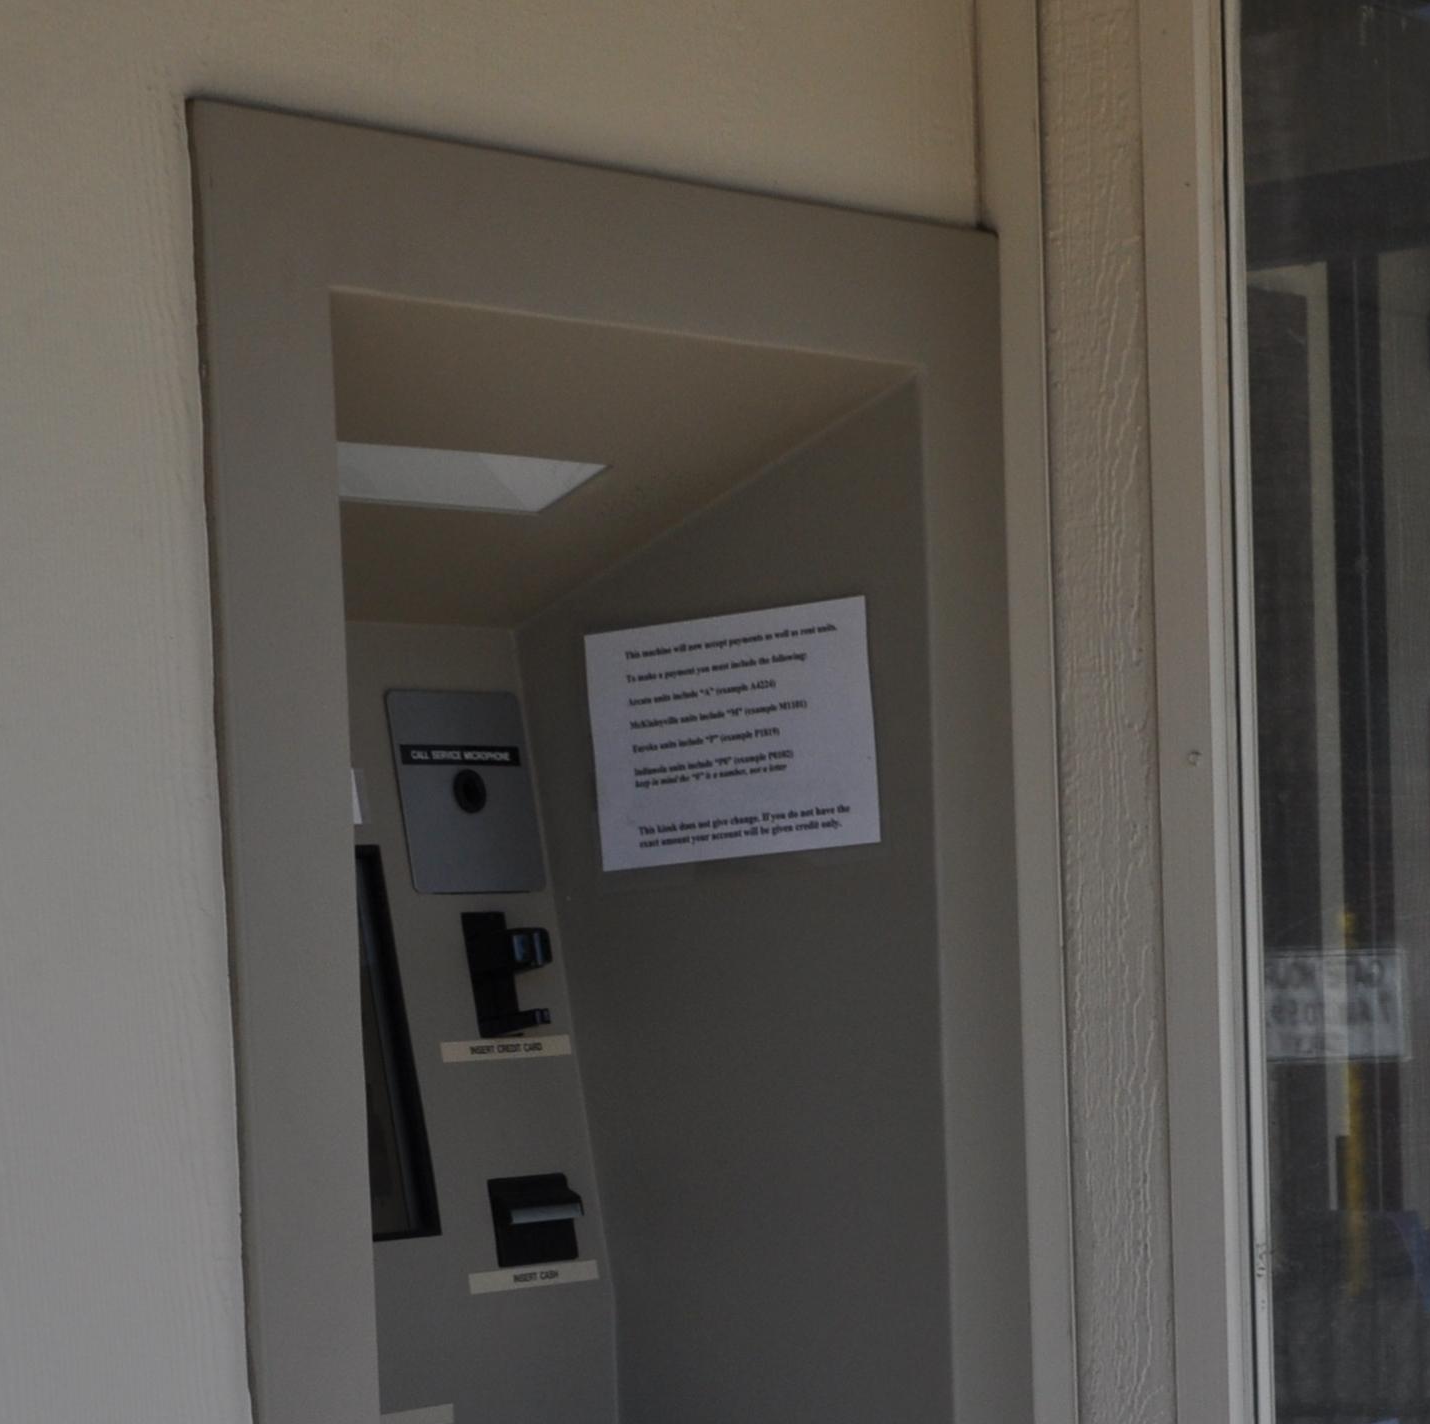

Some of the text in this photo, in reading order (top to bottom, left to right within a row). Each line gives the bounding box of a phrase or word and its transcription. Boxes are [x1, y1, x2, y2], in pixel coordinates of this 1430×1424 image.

[625, 650, 640, 660] This
[642, 646, 671, 658] machine
[674, 644, 687, 654] will
[688, 643, 702, 652] now
[705, 638, 727, 652] accept
[729, 634, 763, 649] payments
[774, 630, 789, 641] well
[801, 627, 815, 638] rent
[638, 671, 657, 682] make
[664, 666, 695, 680] payment
[696, 666, 710, 676] you
[711, 662, 729, 673] must
[730, 658, 757, 670] include
[758, 657, 770, 667] the
[653, 693, 671, 704] units
[672, 690, 698, 701] include
[680, 713, 698, 724] units
[699, 710, 725, 722] include
[659, 740, 677, 750] units
[678, 736, 704, 748] include
[411, 750, 511, 761] CALL SERVICE MICROPHONE
[669, 762, 686, 772] units
[687, 759, 713, 770] include
[639, 825, 656, 835] This
[679, 821, 696, 831] does
[698, 819, 711, 829] not
[712, 817, 728, 829] give
[771, 813, 786, 823] you
[799, 809, 814, 819] not
[815, 806, 835, 817] have
[837, 805, 851, 815] the
[639, 837, 660, 847] exact
[661, 834, 691, 845] amount
[691, 834, 710, 844] your
[711, 829, 743, 840] account
[743, 827, 759, 837] will
[771, 824, 794, 836] given
[795, 821, 820, 832] credit
[469, 1042, 543, 1055] INSERT CREDIT CARD
[513, 1270, 559, 1283] INSERT CASH
